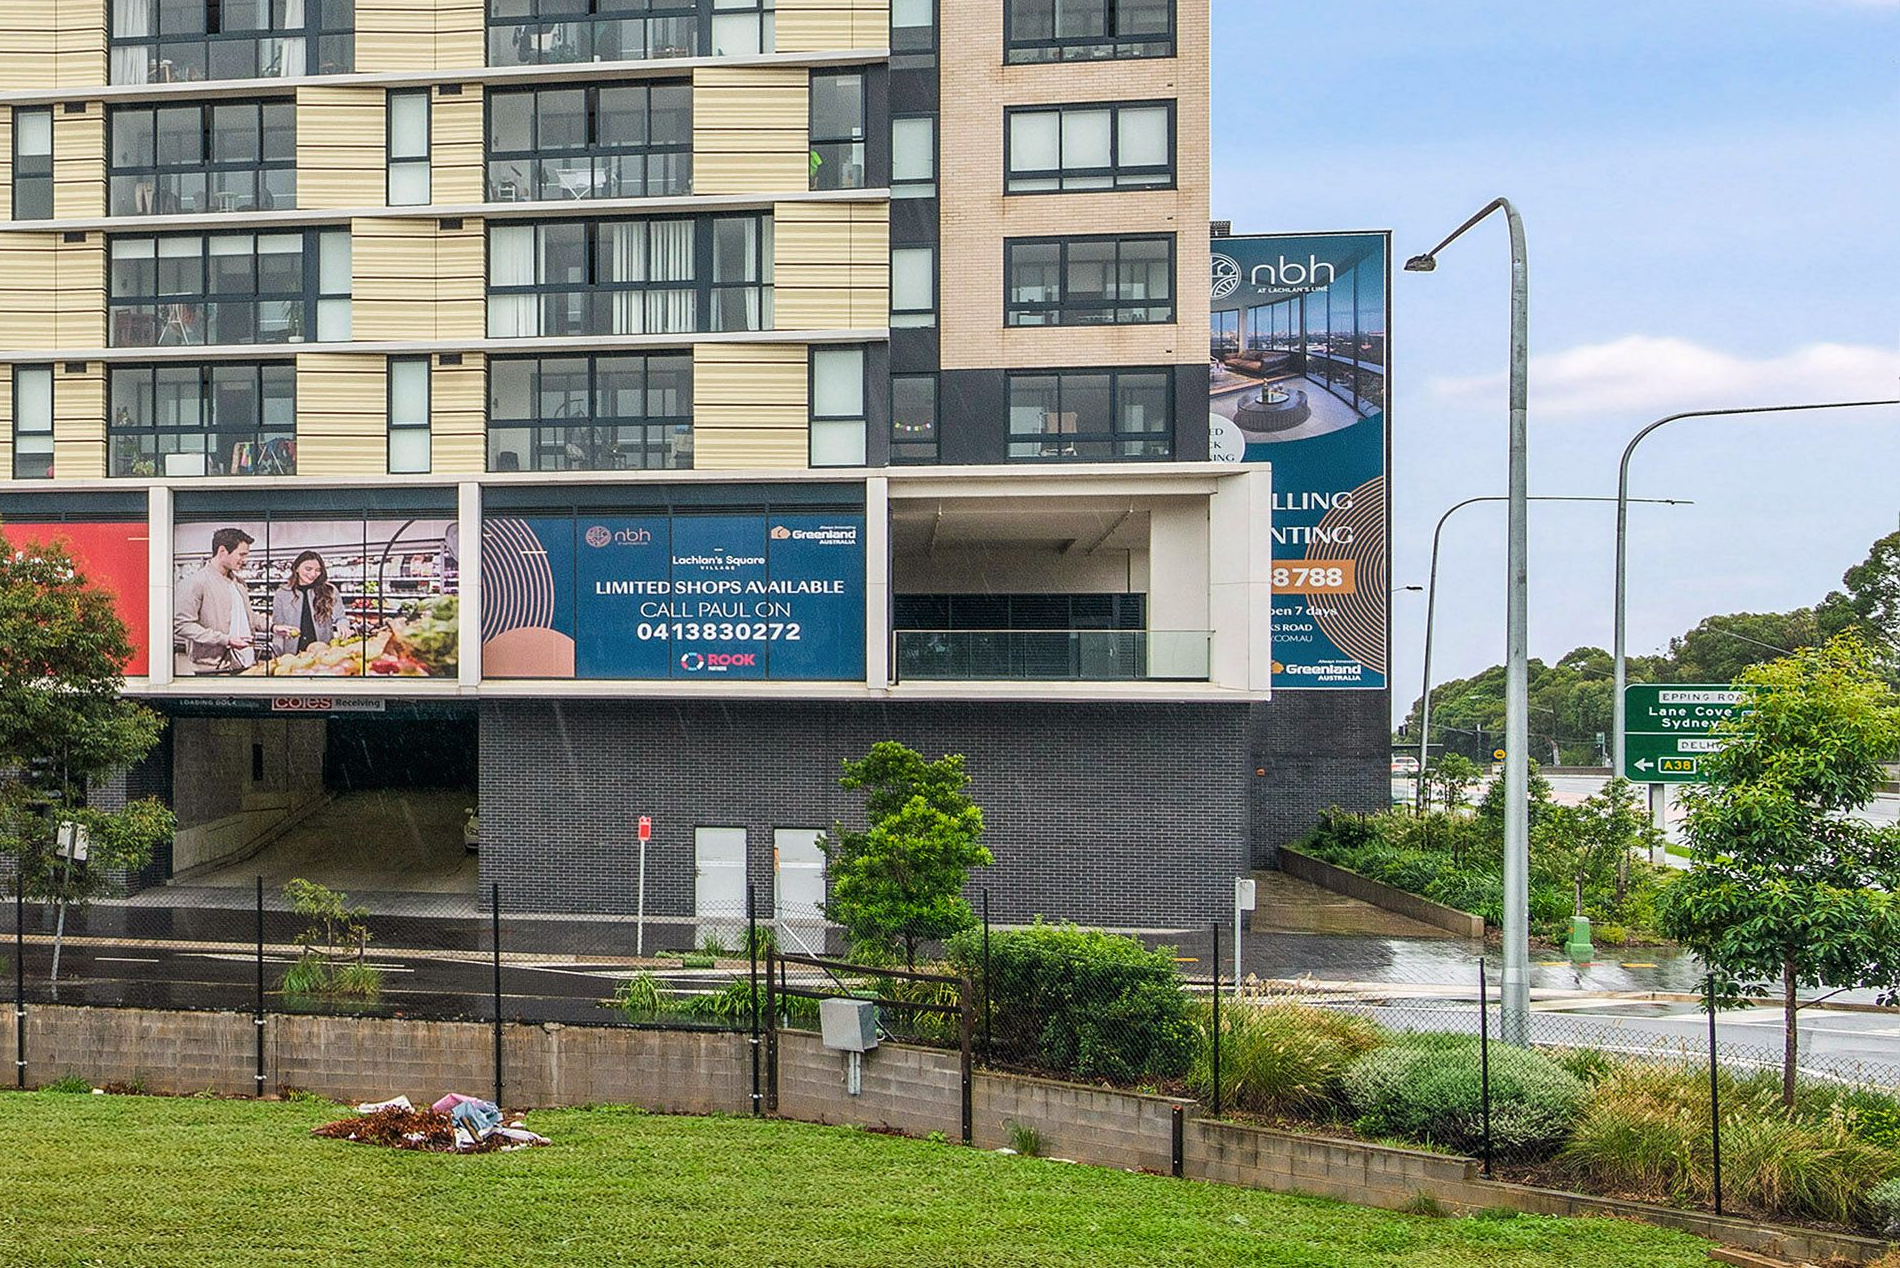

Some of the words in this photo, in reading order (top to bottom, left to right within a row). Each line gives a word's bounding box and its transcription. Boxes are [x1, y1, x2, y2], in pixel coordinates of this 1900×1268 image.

[1251, 254, 1335, 285] nbh
[1272, 491, 1354, 510] LLING
[614, 527, 651, 542] nbh
[792, 529, 857, 539] Greenland
[1271, 525, 1354, 545] NTING
[672, 555, 722, 565] Lachlan's
[726, 555, 765, 568] Square
[596, 581, 671, 594] LIMITED
[675, 581, 742, 595] SHOPS
[745, 580, 844, 594] AVAILABLE
[640, 602, 693, 618] CALL
[698, 602, 751, 618] PAUL
[755, 601, 791, 617] ON
[1270, 608, 1292, 618] pen
[1294, 606, 1302, 615] 7
[1306, 606, 1338, 617] days
[636, 623, 801, 640] 0413830272
[708, 654, 756, 666] ROOK
[1286, 664, 1362, 675] Greenland
[274, 697, 331, 709] coles
[335, 698, 381, 709] Receiving
[1662, 693, 1710, 701] EPPING
[1648, 706, 1687, 716] Lane
[1695, 706, 1733, 716] Cove
[1661, 718, 1720, 729] Sydney
[1681, 741, 1725, 749] DELH
[1663, 760, 1692, 770] A38
